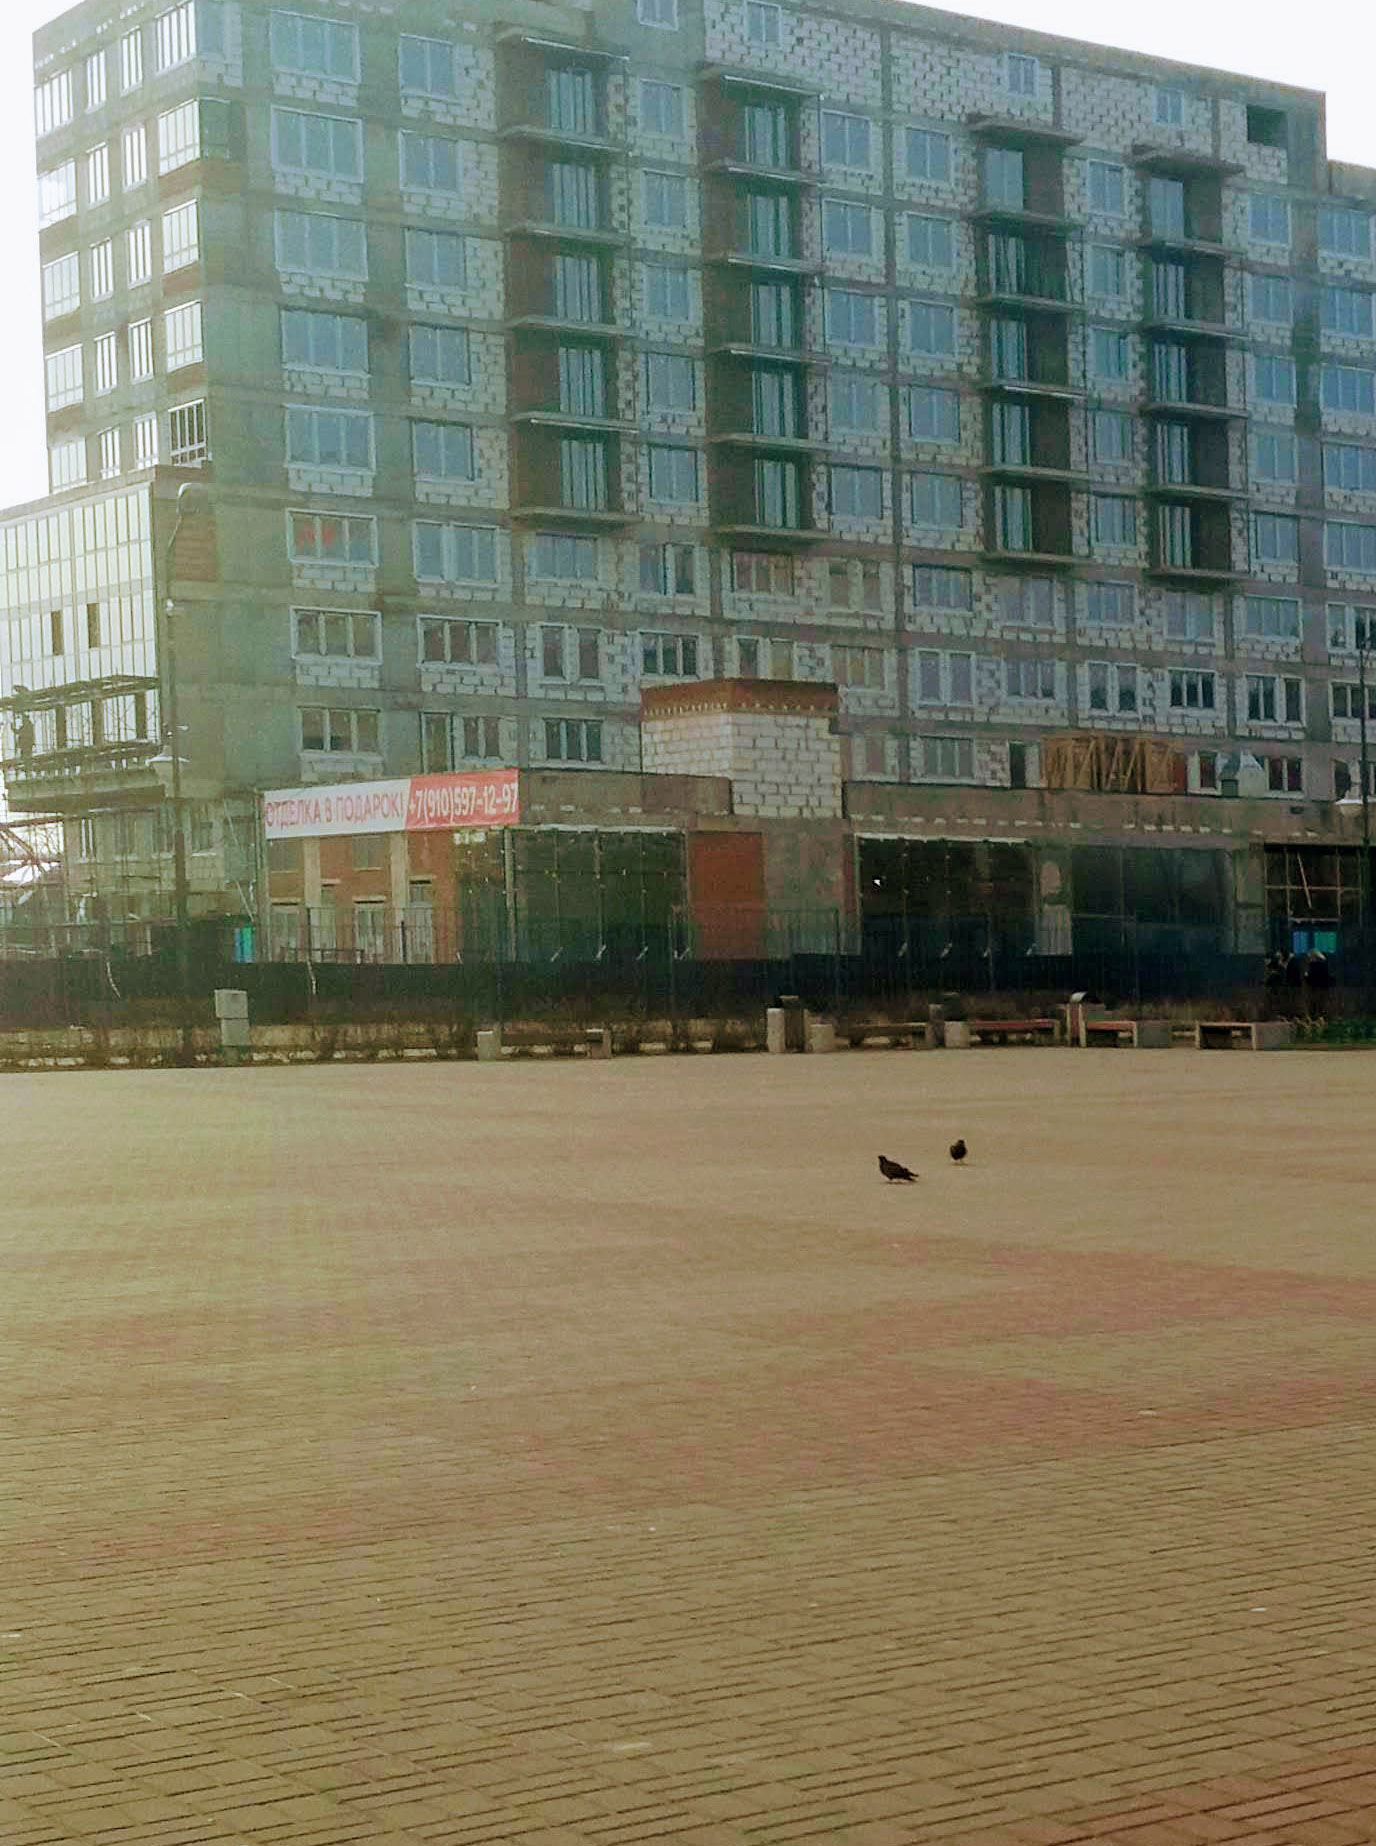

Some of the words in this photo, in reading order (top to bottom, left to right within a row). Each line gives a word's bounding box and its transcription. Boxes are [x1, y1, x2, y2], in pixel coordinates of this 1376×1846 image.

[266, 799, 321, 828] ОТДЕЛКА
[325, 796, 333, 822] В
[409, 783, 518, 818] +7(910)597-12-97
